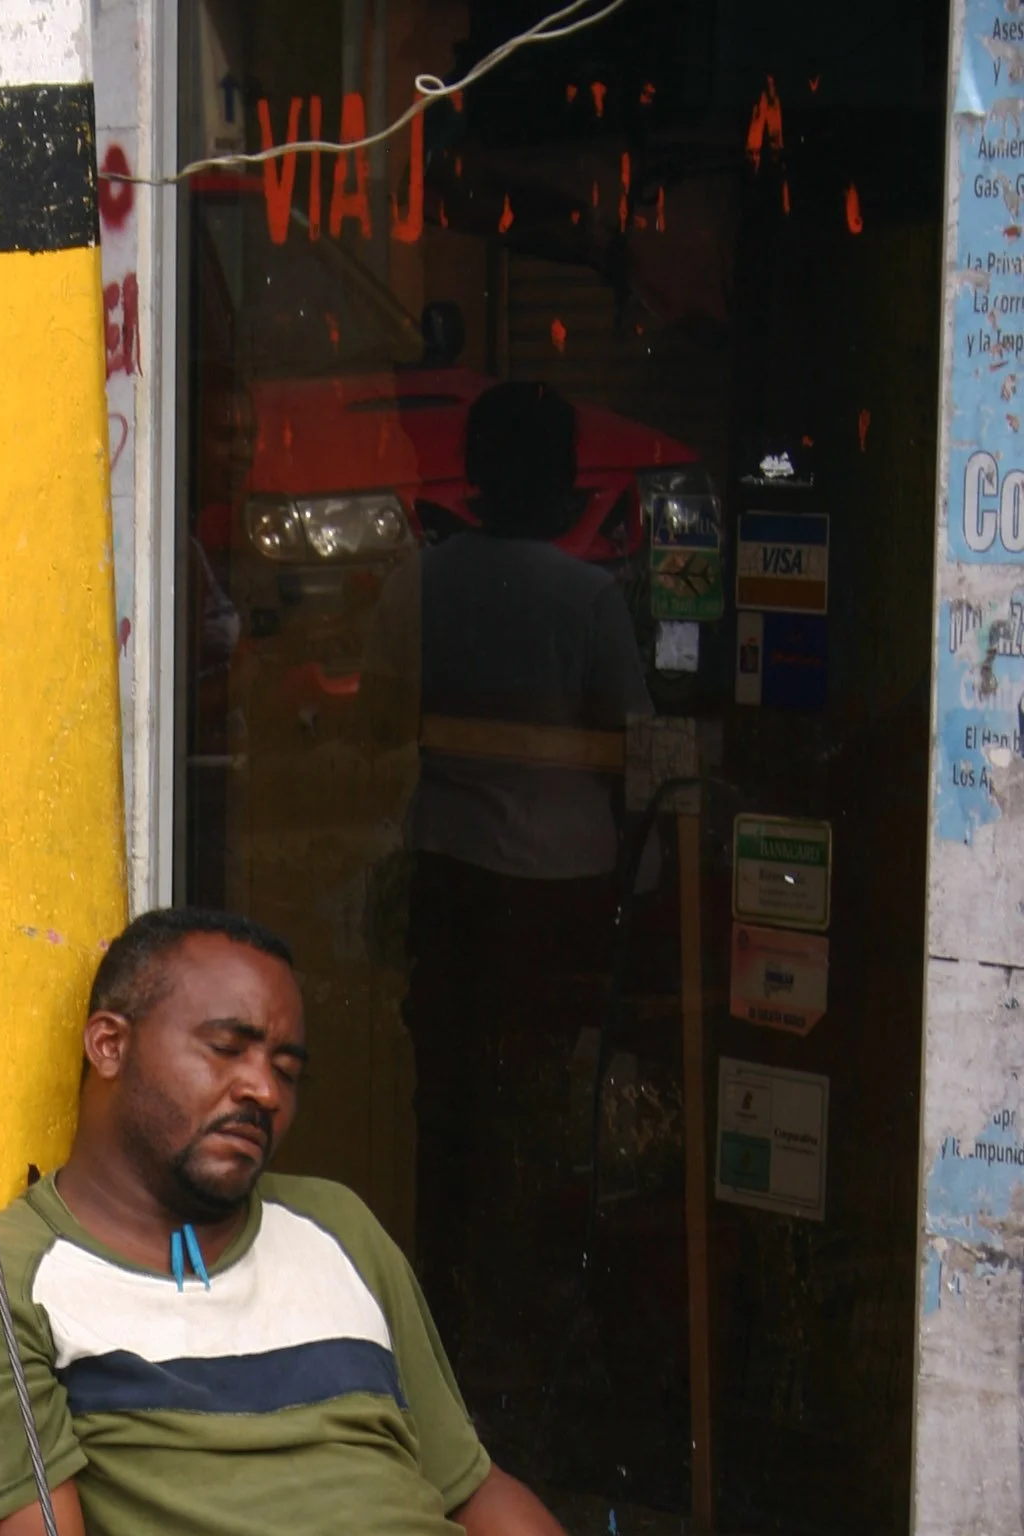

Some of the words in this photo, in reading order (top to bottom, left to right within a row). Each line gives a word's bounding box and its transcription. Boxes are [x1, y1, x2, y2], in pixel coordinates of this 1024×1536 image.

[974, 173, 1000, 198] Gas
[967, 333, 975, 358] y
[979, 328, 991, 353] la
[762, 546, 803, 575] VISA
